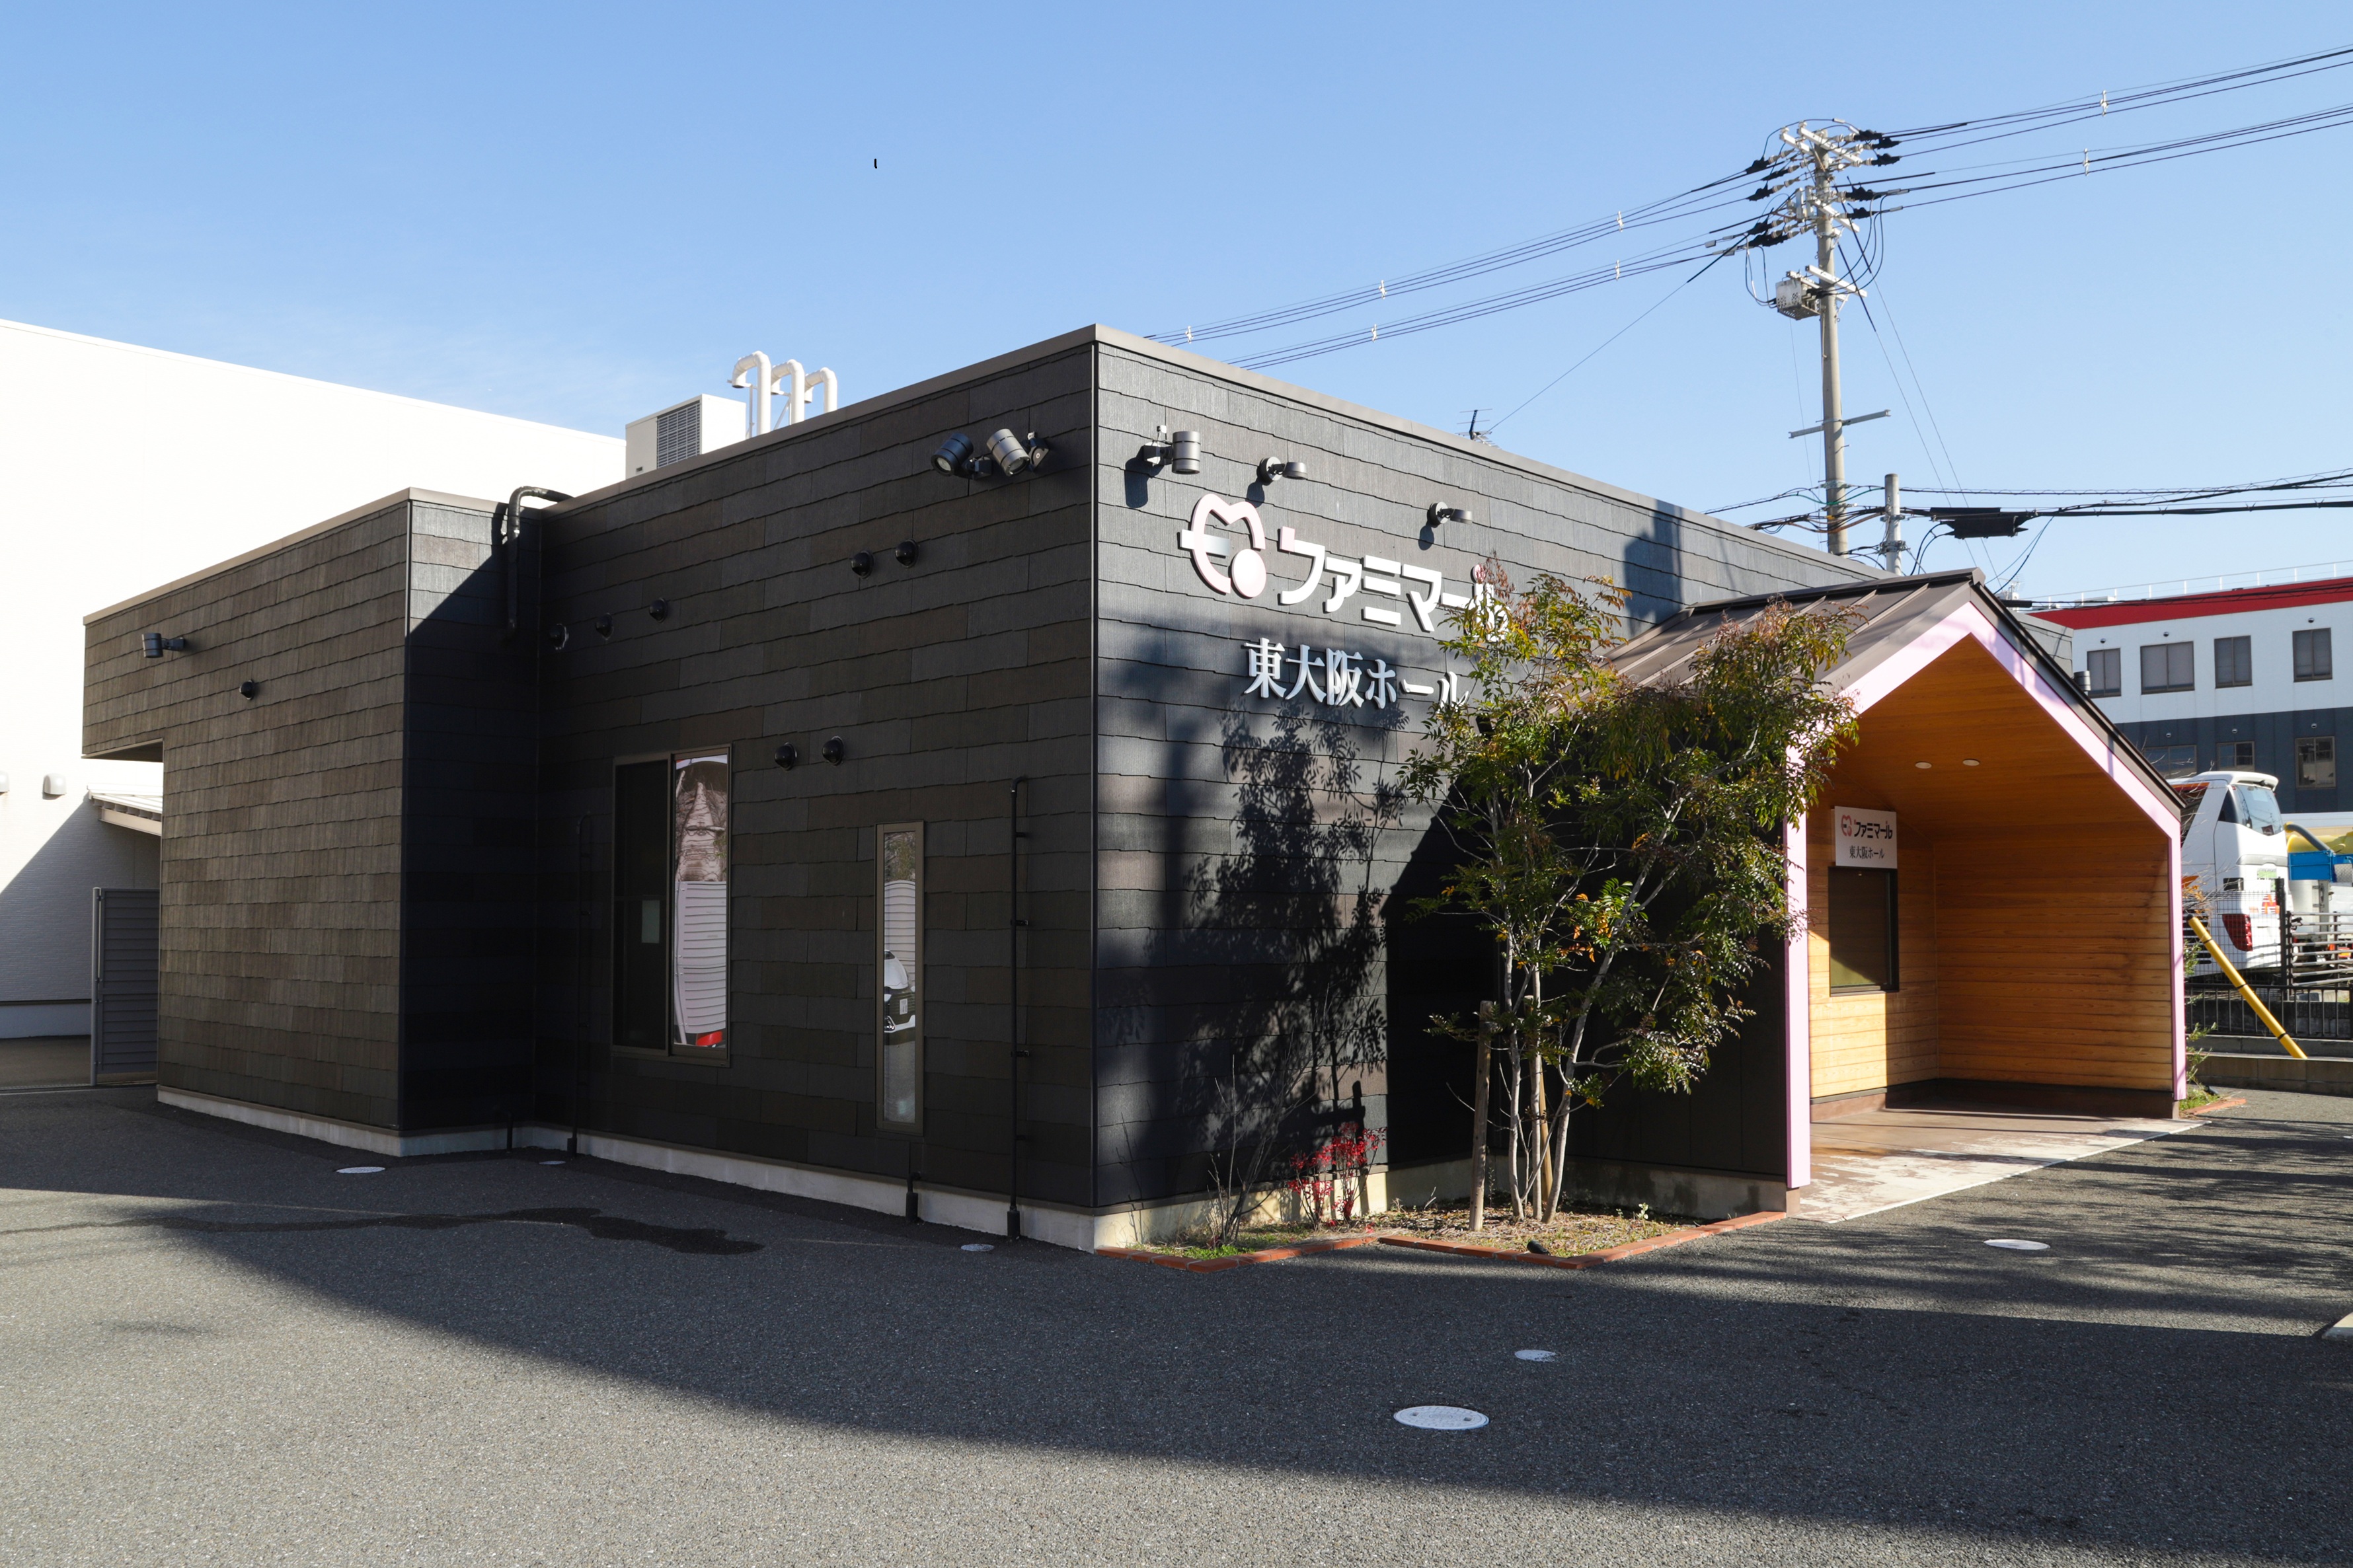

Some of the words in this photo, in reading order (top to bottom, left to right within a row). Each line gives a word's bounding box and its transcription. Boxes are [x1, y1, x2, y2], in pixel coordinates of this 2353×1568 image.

[1243, 637, 1469, 714] 東大阪ホール
[1849, 845, 1885, 860] 東大阪ホール
